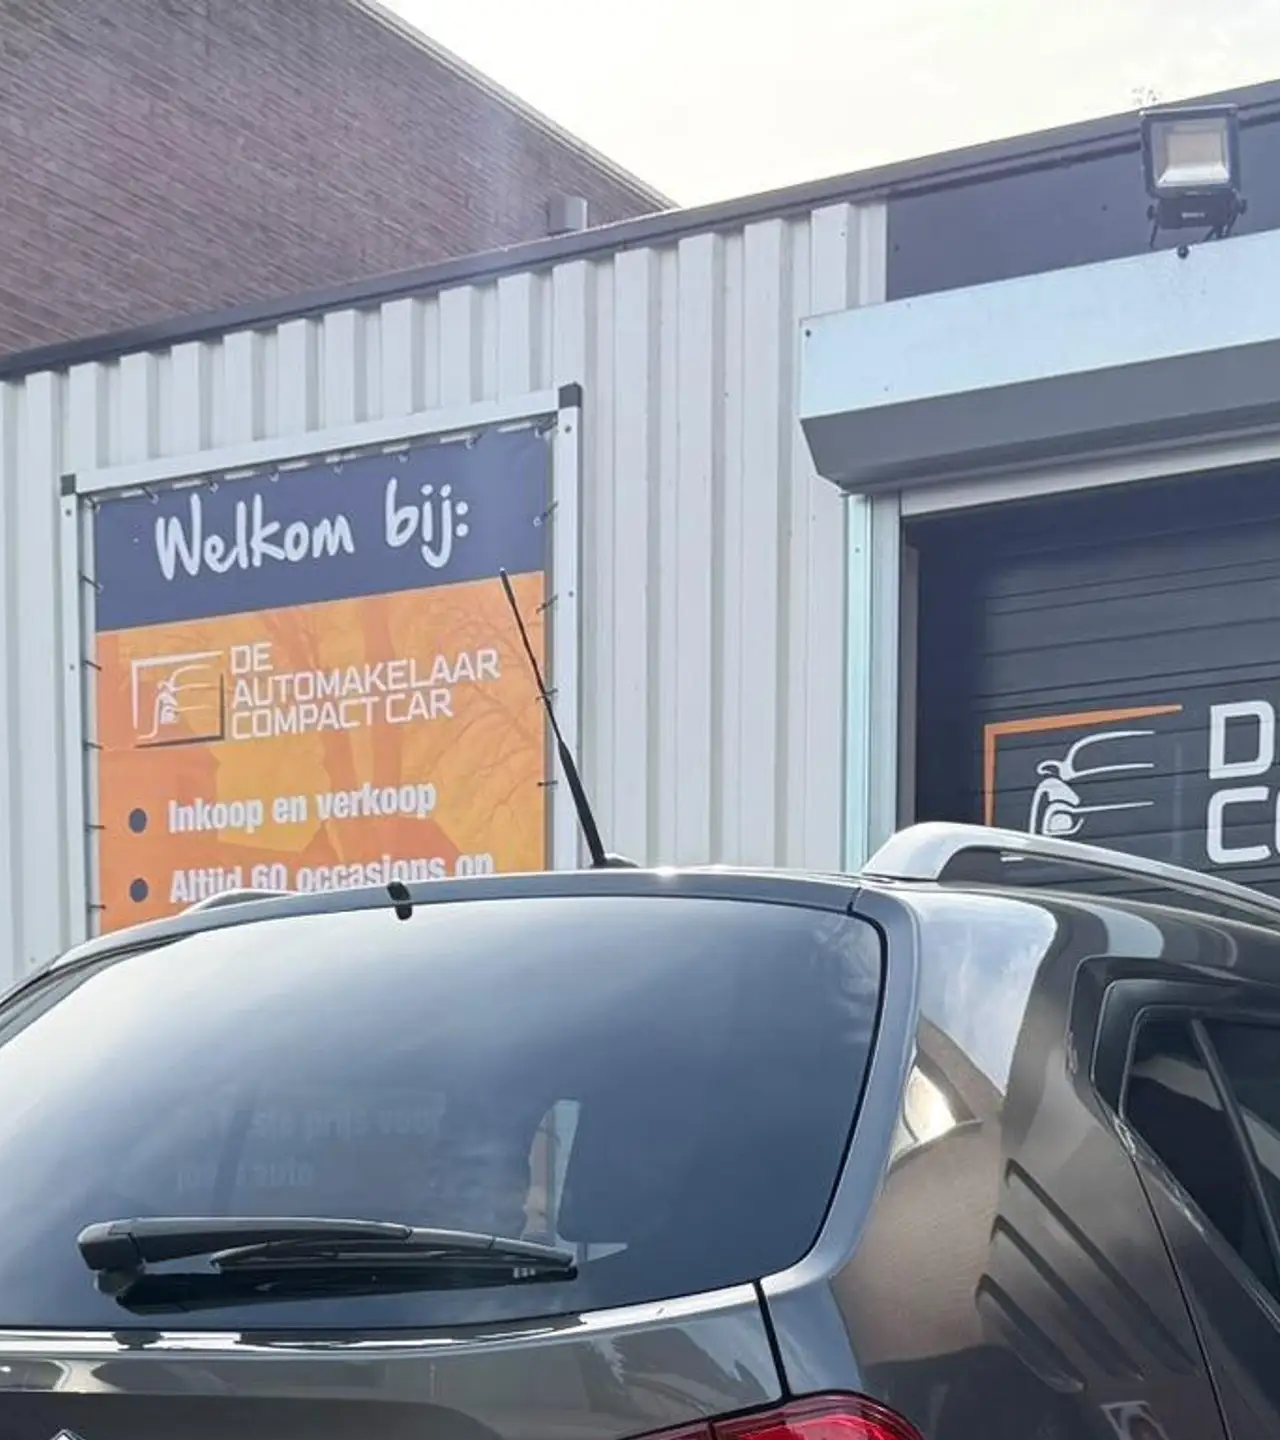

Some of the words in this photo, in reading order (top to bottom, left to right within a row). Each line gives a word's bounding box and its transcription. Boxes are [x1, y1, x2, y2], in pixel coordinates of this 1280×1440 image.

[155, 493, 354, 580] Welkom
[385, 477, 469, 568] bij:
[230, 643, 273, 675] DE
[232, 648, 501, 709] AUTOMAKELAAR
[232, 696, 380, 740] COMPACT
[385, 688, 453, 724] CAR
[168, 799, 264, 833] Inkoop
[272, 794, 307, 824] en
[317, 782, 437, 819] verkoop
[296, 853, 445, 894] occasions
